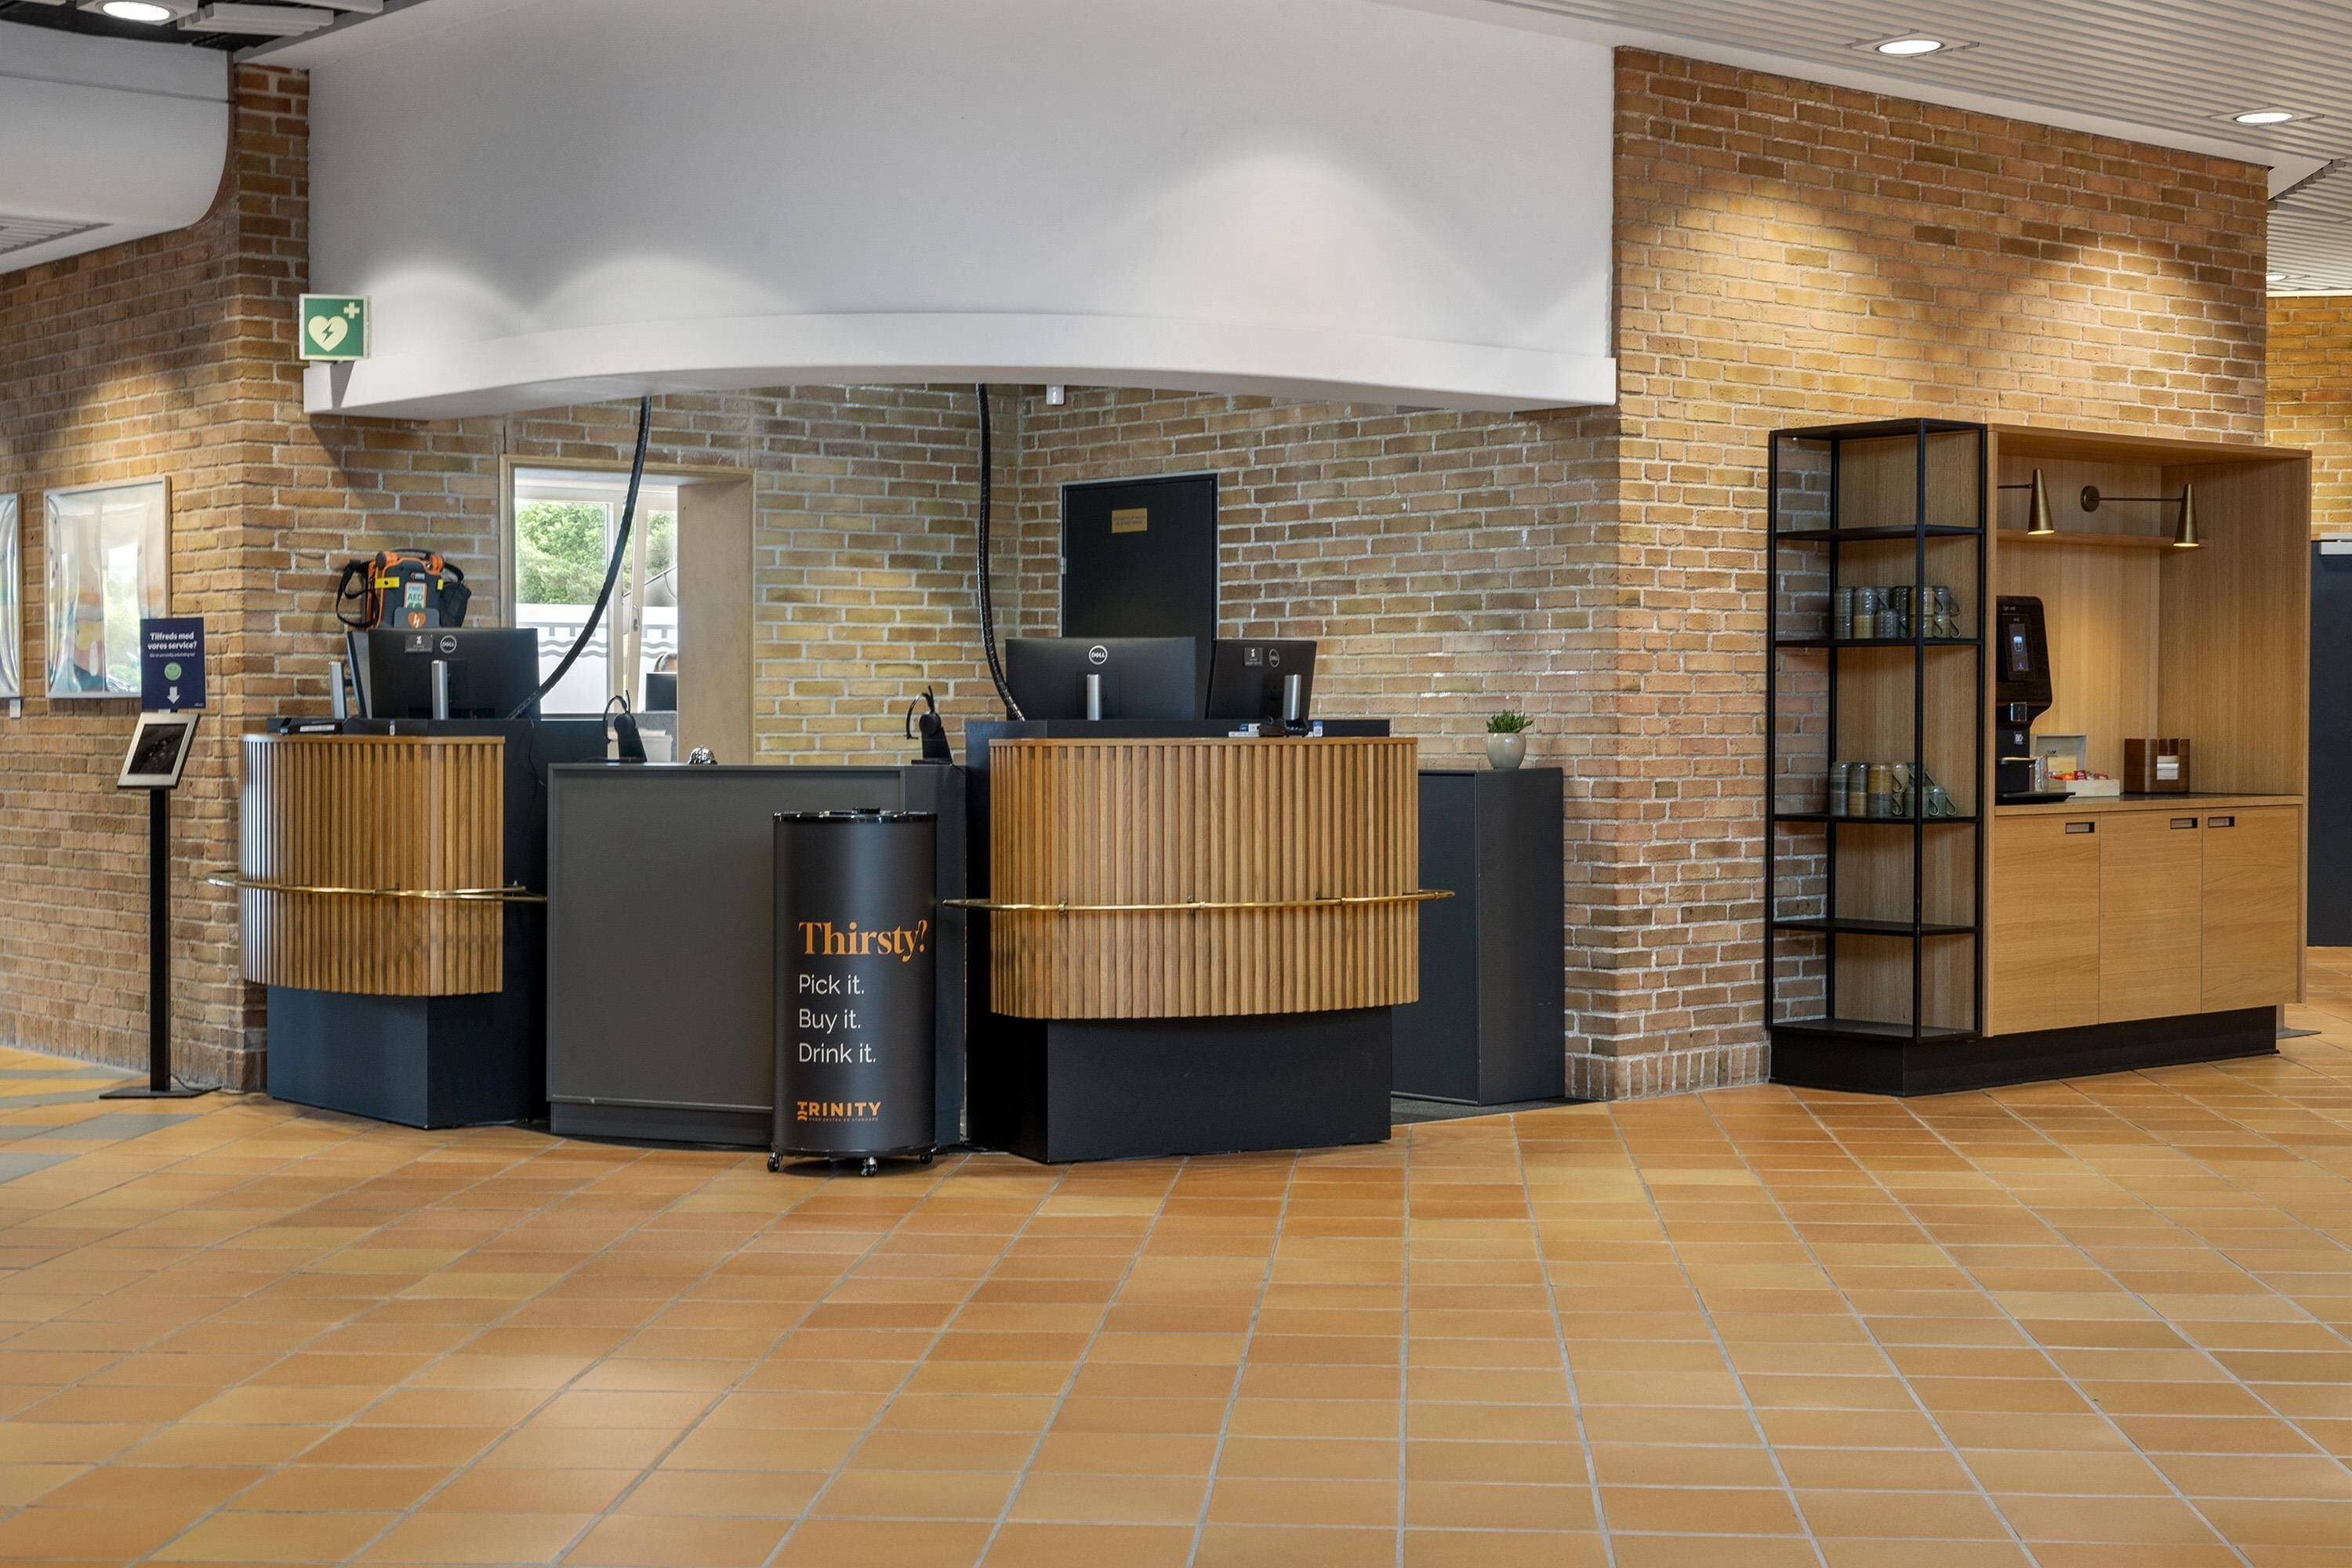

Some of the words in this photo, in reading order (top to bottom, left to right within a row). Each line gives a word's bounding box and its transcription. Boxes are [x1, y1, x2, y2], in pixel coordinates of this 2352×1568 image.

[150, 632, 177, 641] Tilfreds
[179, 631, 194, 640] med
[169, 641, 198, 650] service?
[797, 920, 928, 962] Thirsty?
[799, 974, 840, 994] Pick
[848, 974, 865, 994] it.
[799, 1008, 838, 1034] Buy
[844, 1008, 861, 1029] it.
[799, 1043, 852, 1063] Drink
[859, 1043, 877, 1063] it.
[797, 1102, 881, 1116] TRINITY
